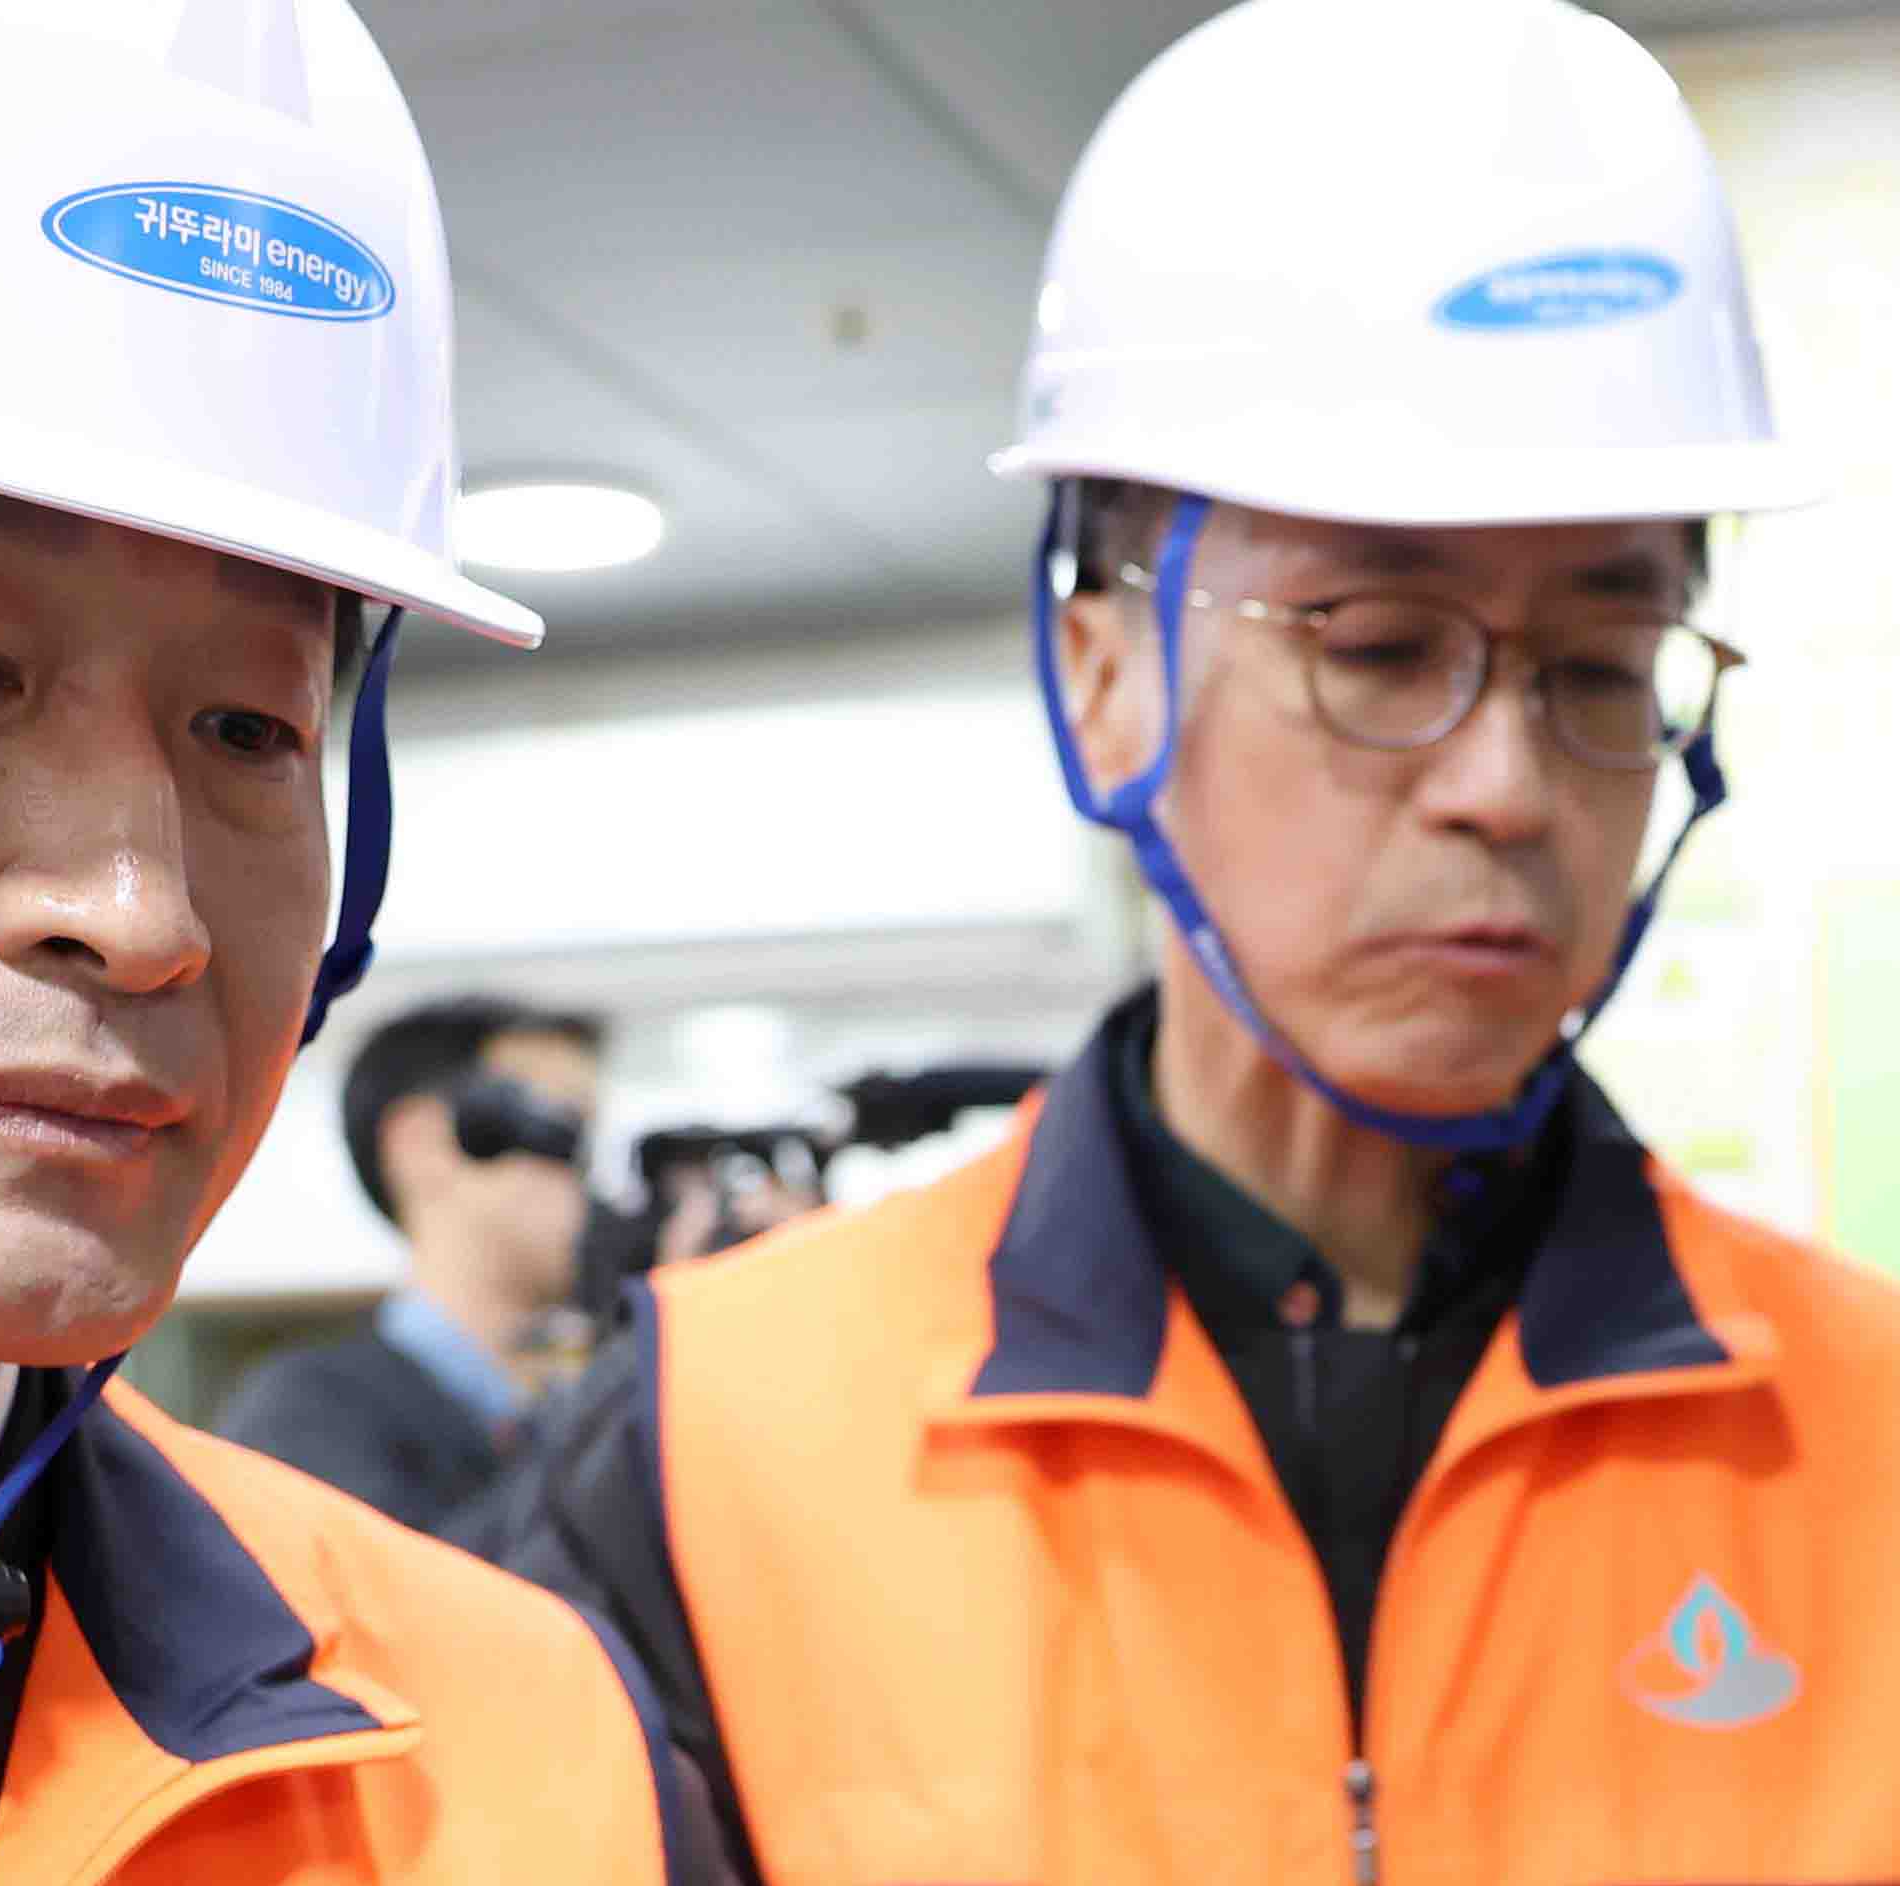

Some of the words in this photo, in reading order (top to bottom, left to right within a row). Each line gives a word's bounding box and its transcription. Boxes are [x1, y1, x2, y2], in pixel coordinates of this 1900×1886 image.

[133, 197, 261, 266] 귀뚜라미
[266, 238, 367, 307] energy
[199, 256, 254, 289] SINCE
[258, 273, 294, 302] 1984
